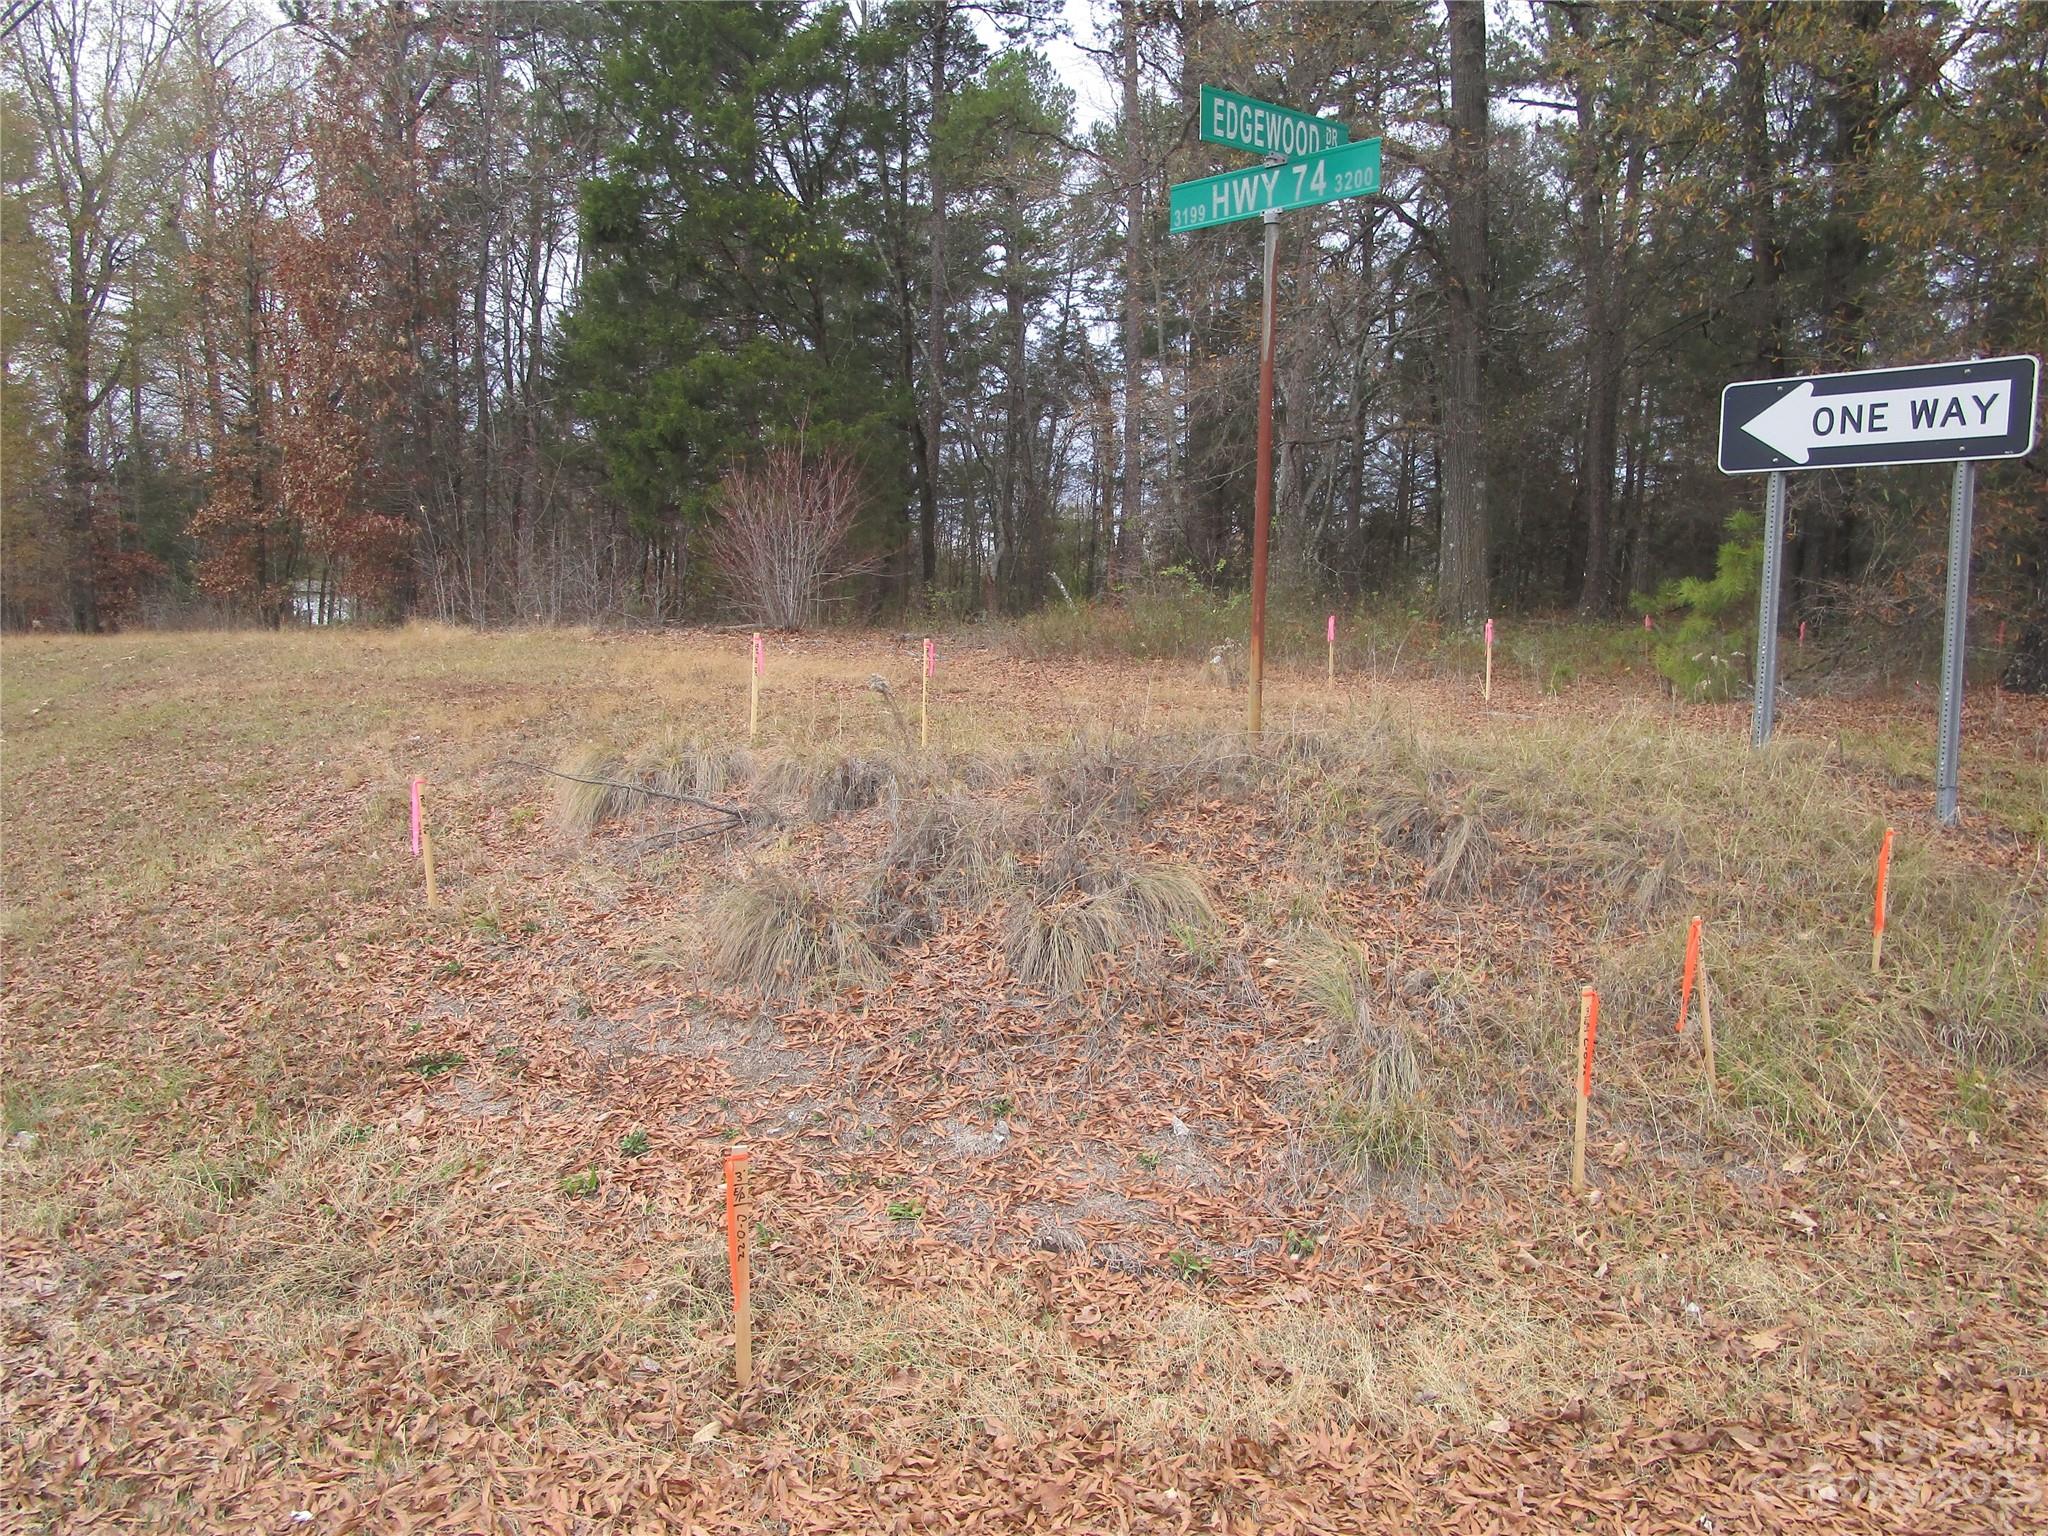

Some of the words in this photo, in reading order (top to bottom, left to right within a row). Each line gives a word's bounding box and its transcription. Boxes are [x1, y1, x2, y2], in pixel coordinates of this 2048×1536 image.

[1213, 96, 1320, 157] EDGEWOOD
[1325, 126, 1339, 148] DR
[1174, 203, 1207, 228] 3199
[1211, 169, 1281, 220] HWY
[1292, 159, 1327, 202] 74
[1334, 167, 1374, 194] 3200
[1812, 401, 1890, 437] ONE
[1910, 392, 2001, 430] WAY
